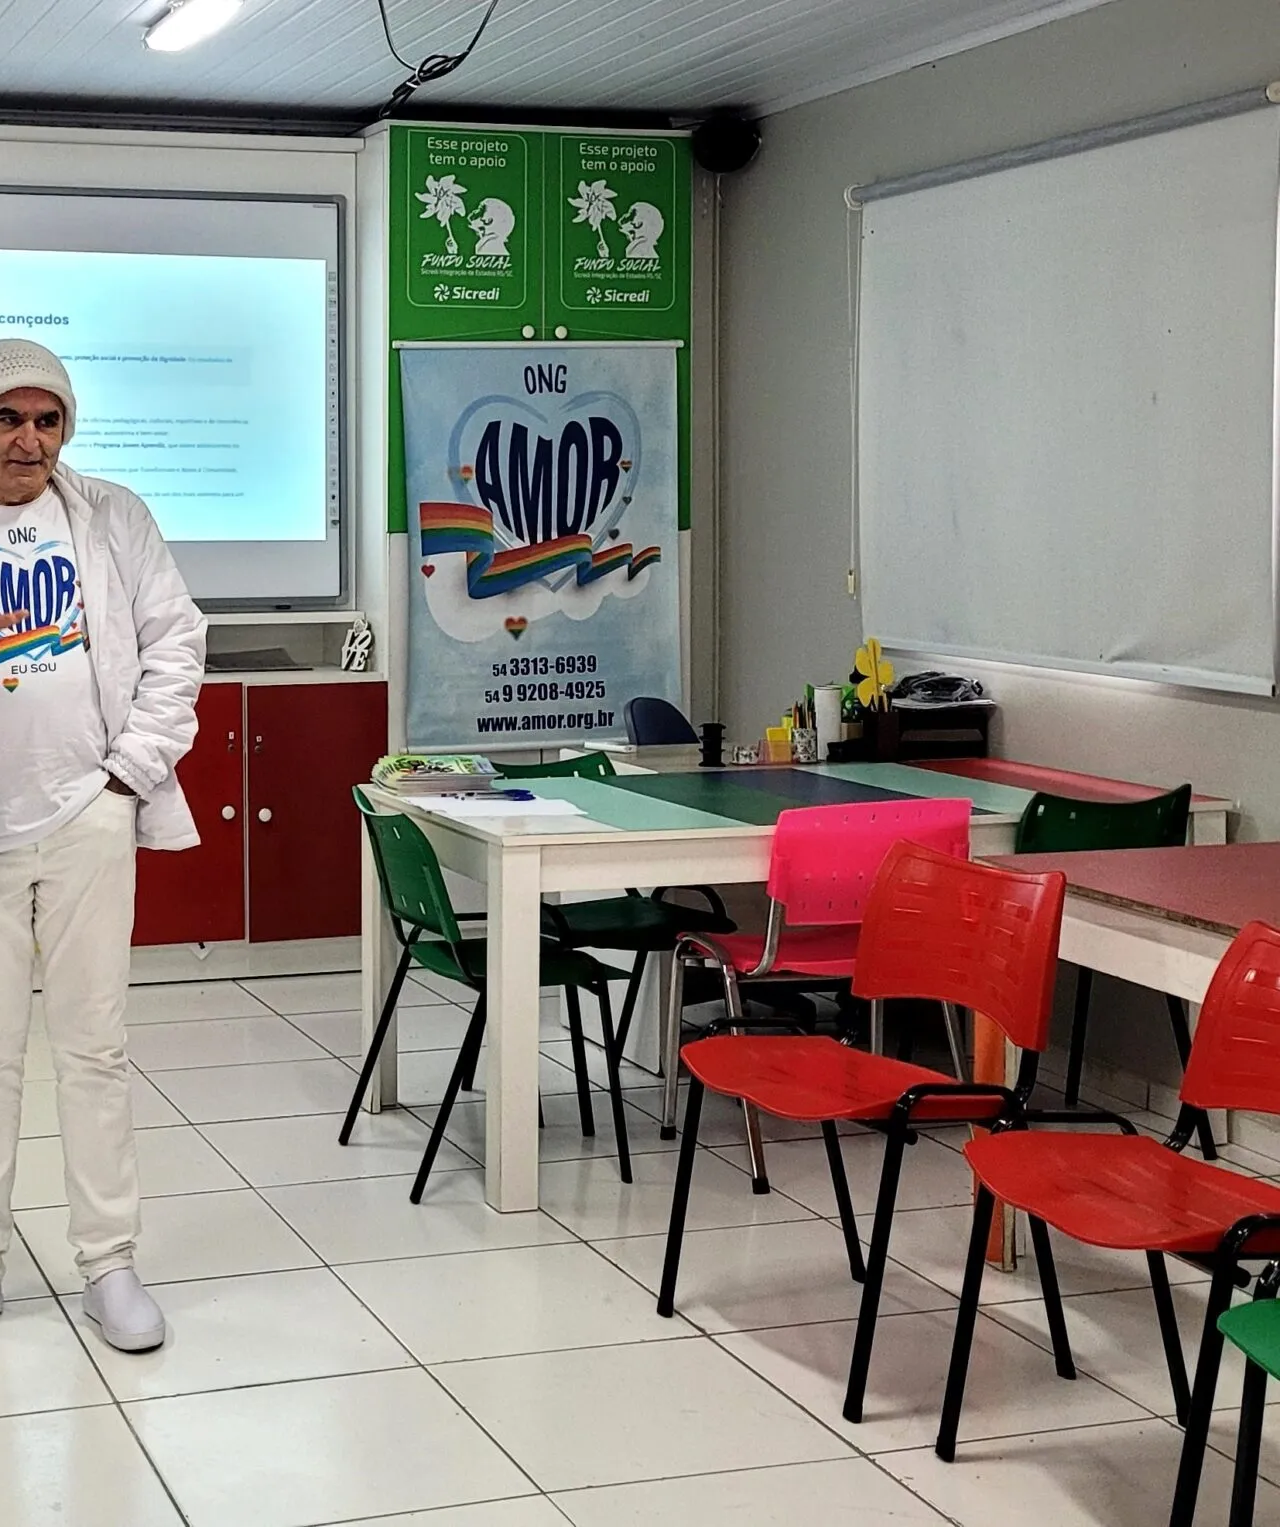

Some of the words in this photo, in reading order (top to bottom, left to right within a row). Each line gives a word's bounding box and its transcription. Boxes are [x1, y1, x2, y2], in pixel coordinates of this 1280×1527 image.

[427, 136, 458, 150] Esse
[461, 139, 509, 154] projeto
[580, 142, 609, 155] Esse
[612, 144, 658, 159] projeto
[429, 153, 456, 165] tem
[458, 156, 467, 166] o
[469, 155, 507, 169] apoio
[581, 159, 607, 171] tem
[609, 161, 618, 171] o
[620, 160, 656, 174] apoio
[421, 253, 464, 268] FUNDO
[465, 256, 513, 269] SOCIAL
[574, 257, 615, 271] FUNDO
[616, 258, 662, 272] SOCIAL
[452, 286, 500, 301] Sicredi
[604, 289, 650, 303] Sicredi
[524, 364, 567, 394] ONG
[476, 416, 623, 546] AMOR
[8, 526, 37, 544] ONG
[11, 665, 28, 675] EU
[30, 662, 57, 673] SOU
[492, 663, 508, 677] 54
[509, 655, 597, 676] 3313-6939
[485, 689, 500, 703] 54
[502, 684, 513, 703] 9
[517, 680, 606, 701] 9208-4925
[477, 710, 615, 733] www.amor.org.br
